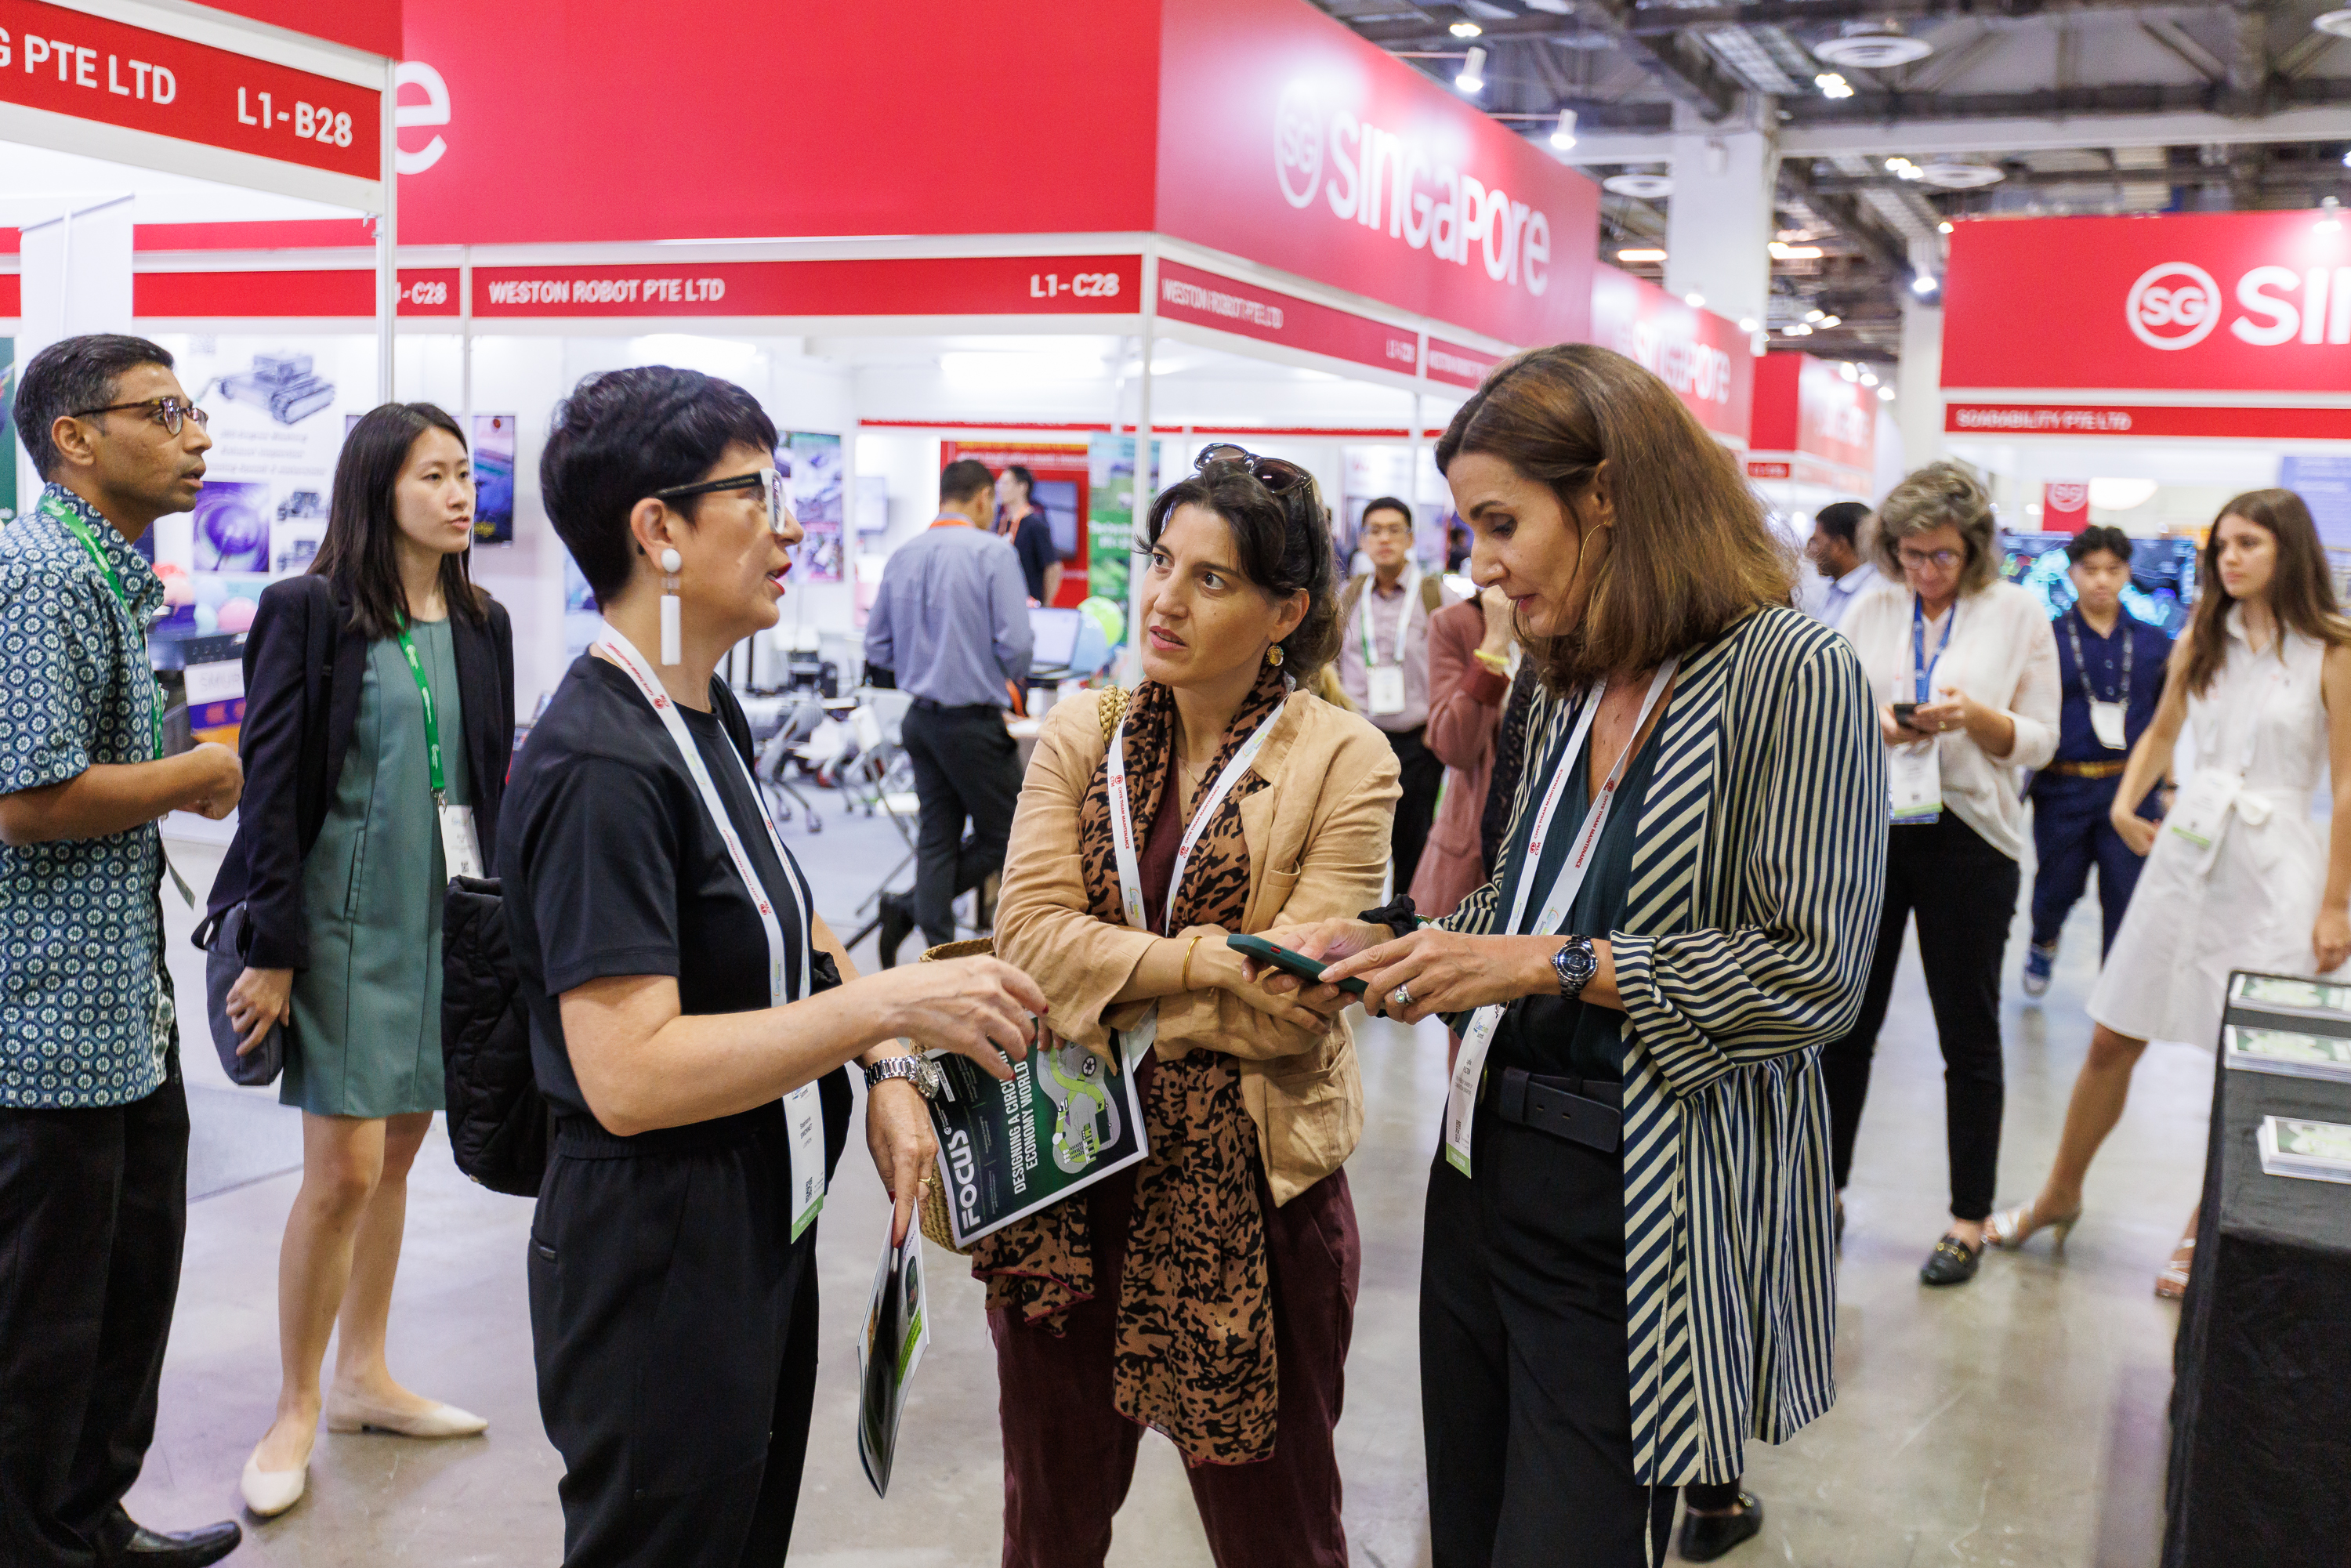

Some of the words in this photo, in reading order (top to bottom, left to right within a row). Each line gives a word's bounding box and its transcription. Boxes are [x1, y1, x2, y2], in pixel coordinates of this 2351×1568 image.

[24, 34, 97, 89] PTE
[108, 54, 176, 104] LTD
[237, 86, 353, 148] L1-B28
[489, 280, 570, 304] WESTON
[573, 278, 640, 303] ROBOT
[643, 278, 683, 302] PTE
[685, 277, 726, 302] LTD
[1031, 273, 1120, 297] L1-C28
[998, 1050, 1020, 1115] CIRCU
[1014, 1060, 1034, 1108] WORLD
[1008, 1114, 1020, 1125] A
[1021, 1108, 1038, 1171] ECONOMY
[947, 1129, 980, 1229] FOCUS
[1009, 1125, 1027, 1194] DESIGNING
